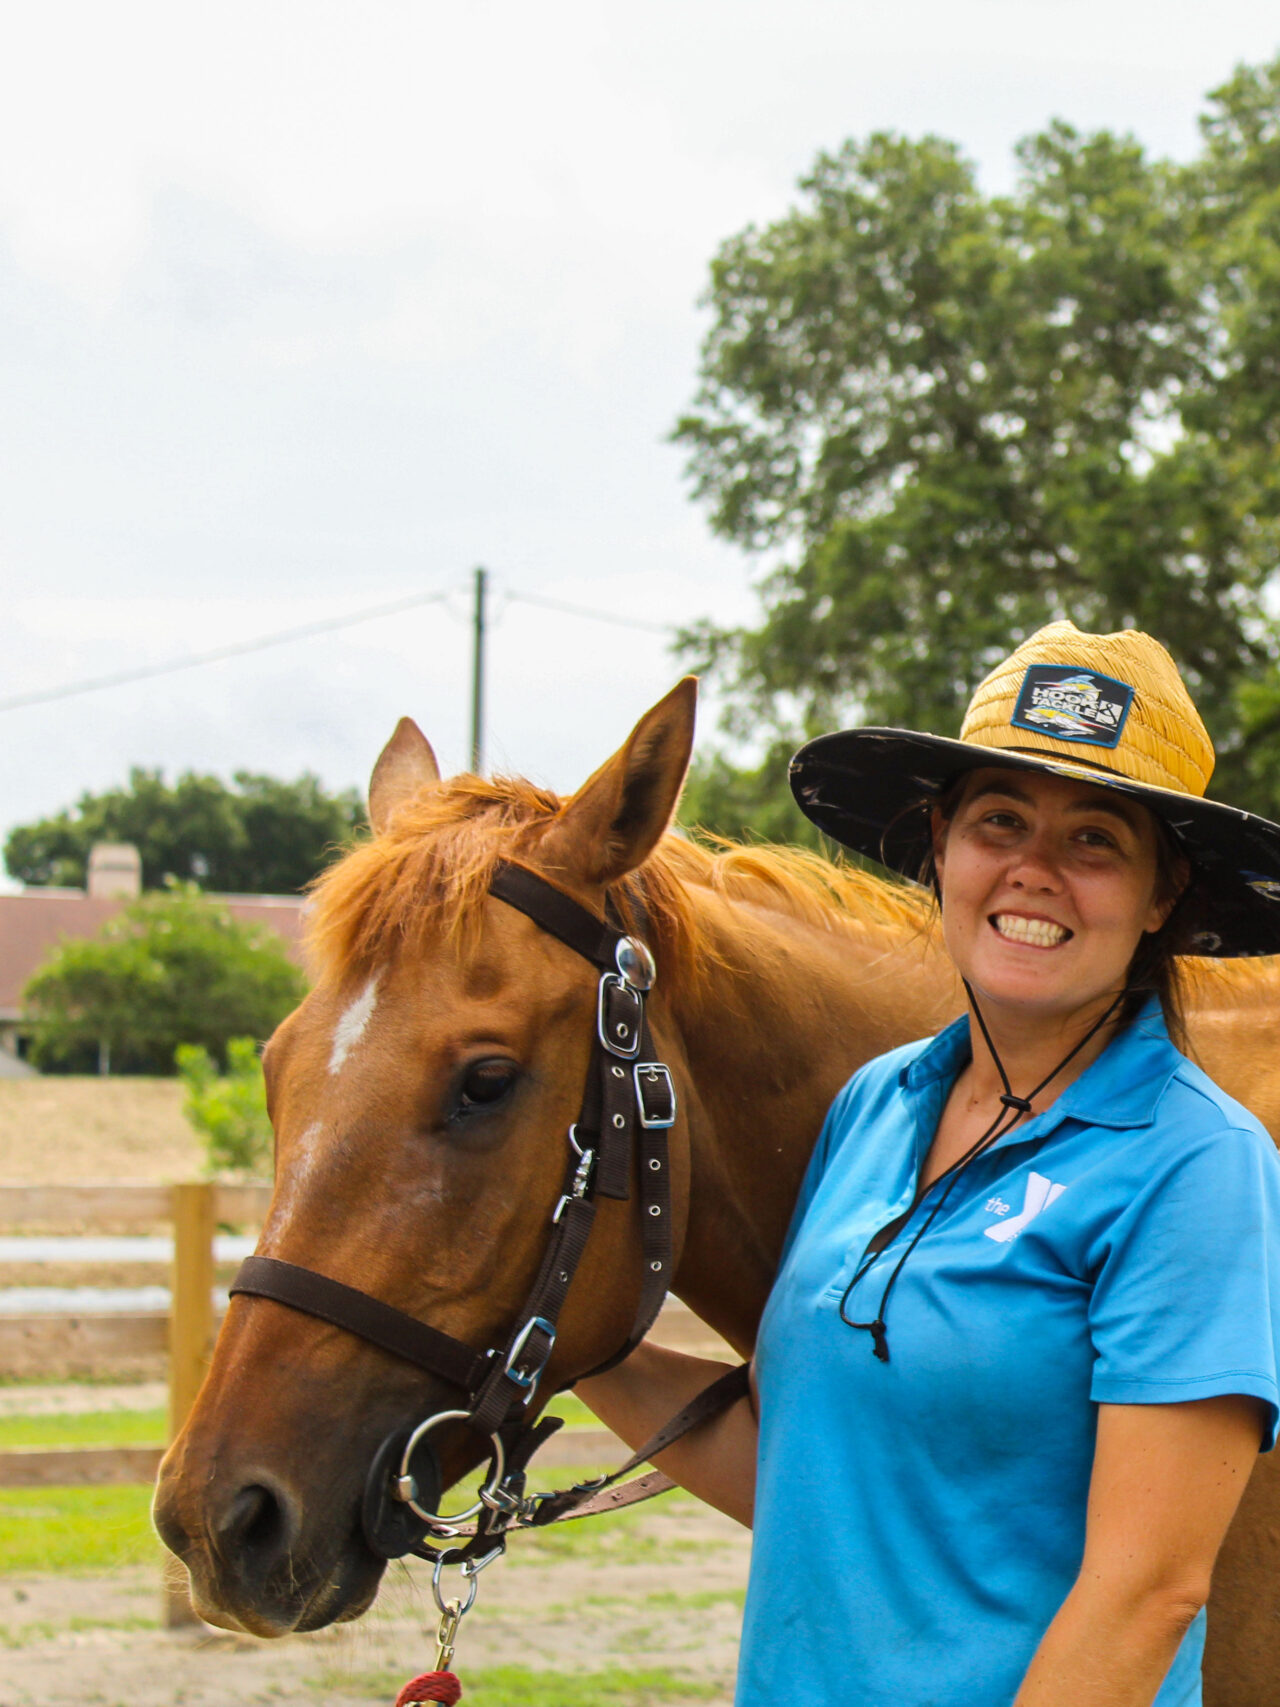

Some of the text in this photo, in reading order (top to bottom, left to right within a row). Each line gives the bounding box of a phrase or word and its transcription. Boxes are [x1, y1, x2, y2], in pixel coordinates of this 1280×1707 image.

[1031, 696, 1097, 719] TACKLE
[1032, 687, 1099, 710] HOOK
[985, 1197, 1010, 1216] the
